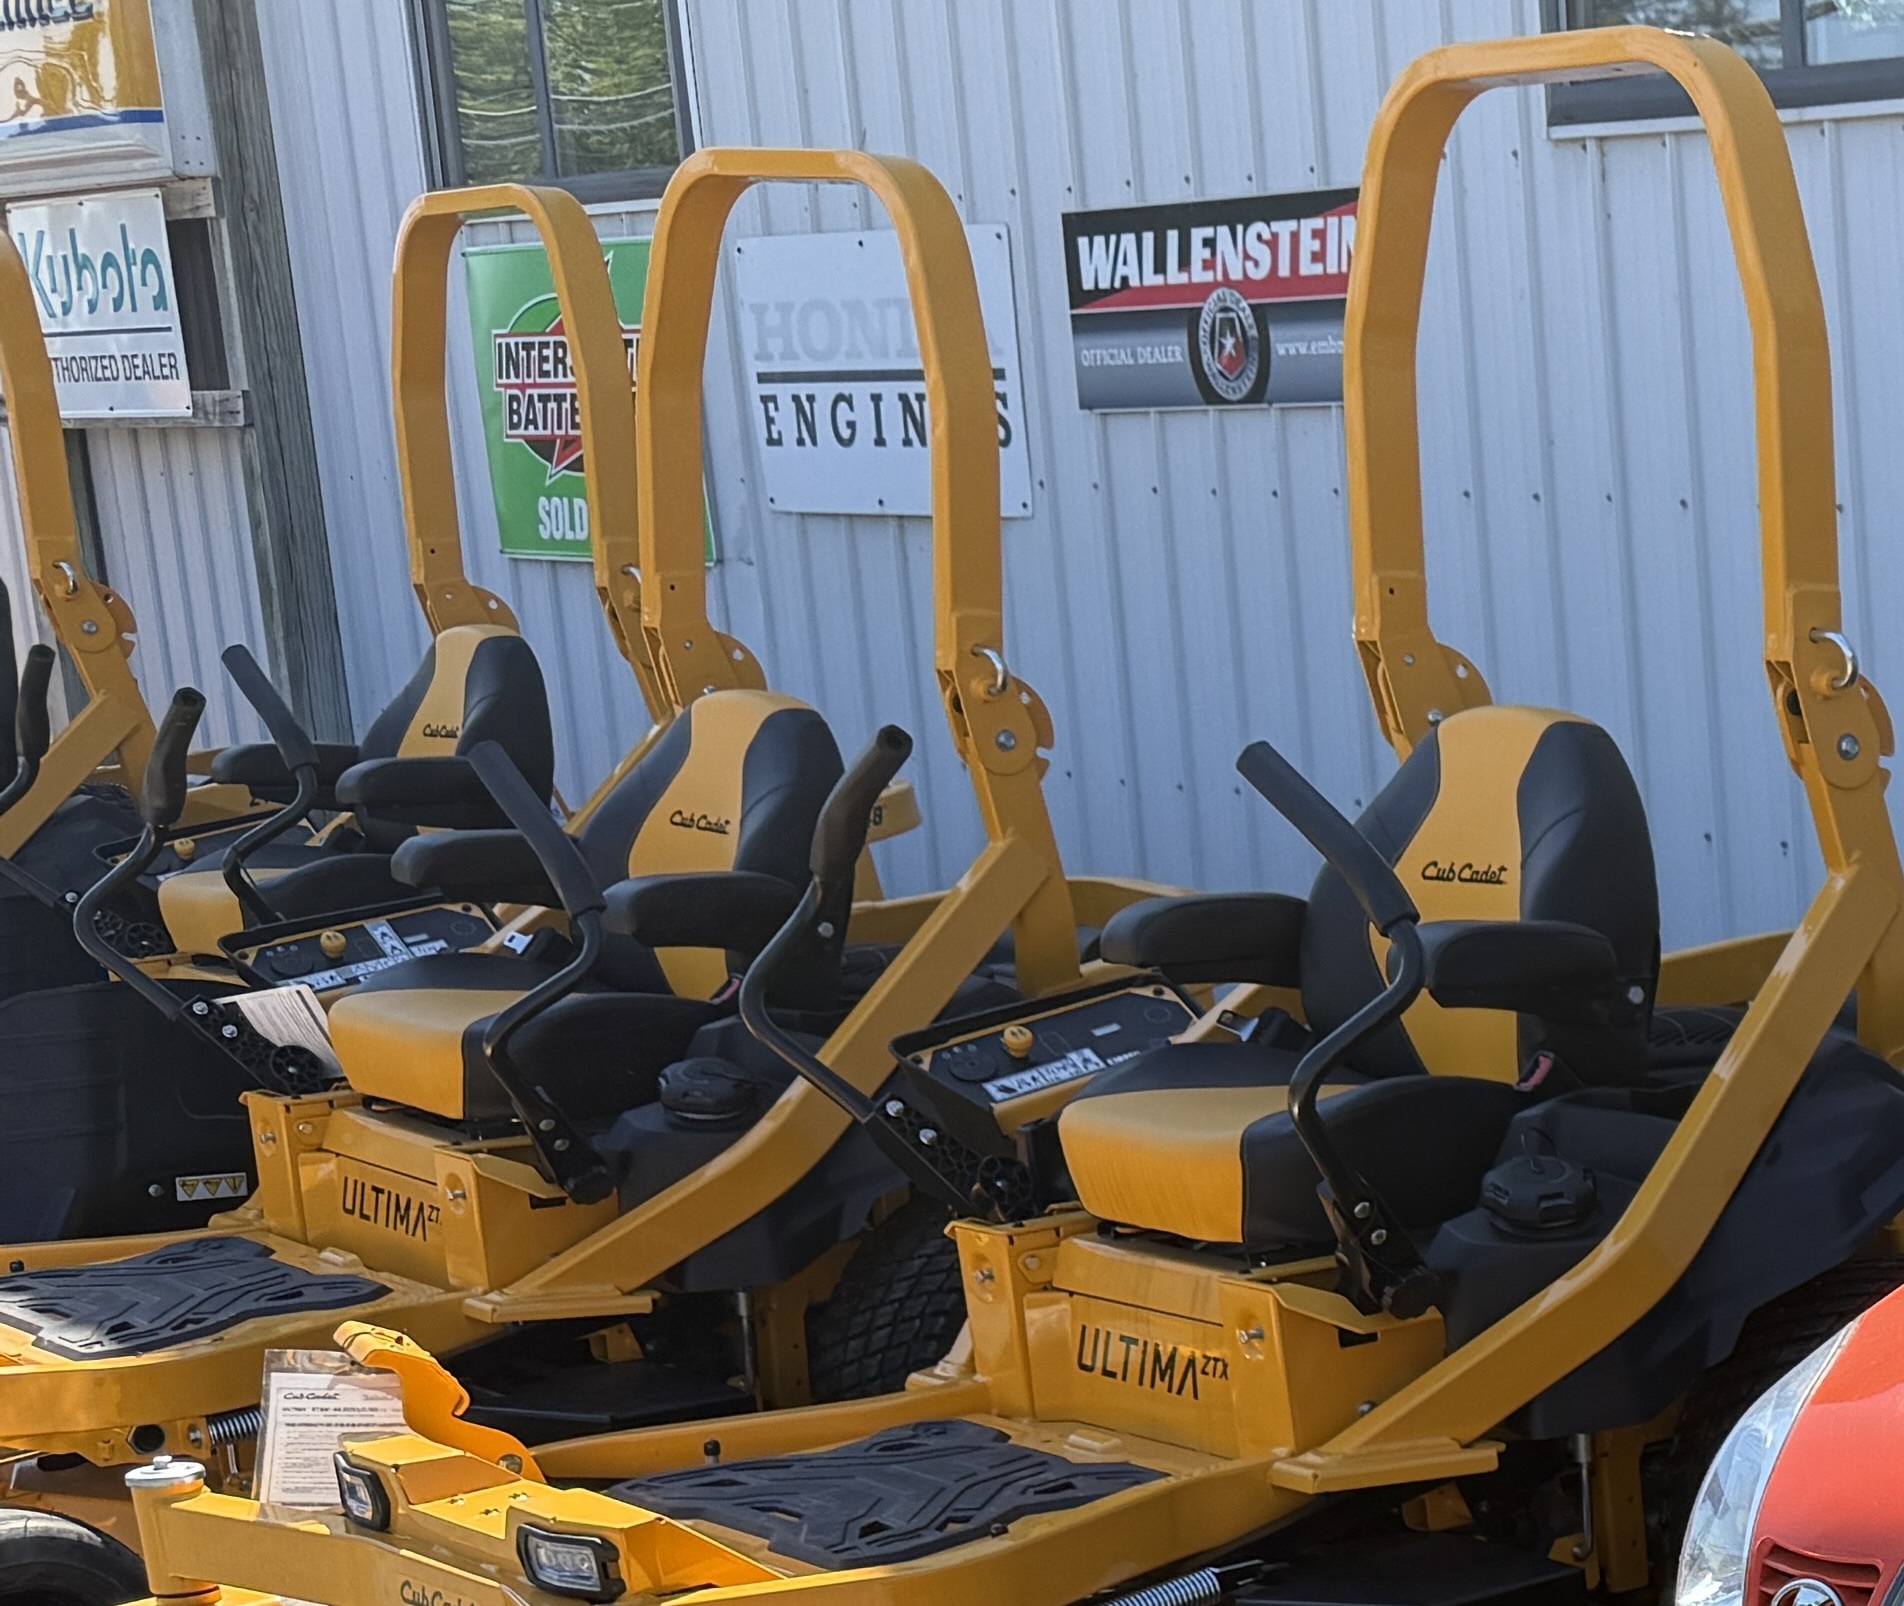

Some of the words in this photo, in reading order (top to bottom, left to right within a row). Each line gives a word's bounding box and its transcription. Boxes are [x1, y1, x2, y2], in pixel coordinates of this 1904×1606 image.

[18, 223, 168, 318] Kubota
[52, 355, 119, 383] THORIZED
[122, 352, 180, 381] DEALER
[1137, 346, 1183, 364] DEALER
[760, 392, 1012, 448] ENGINS
[538, 497, 588, 540] SOLD
[1421, 861, 1456, 882] Cub
[1457, 862, 1507, 885] Cadet
[342, 1176, 427, 1242] ULTIMA
[1077, 1324, 1199, 1401] ULTIMA
